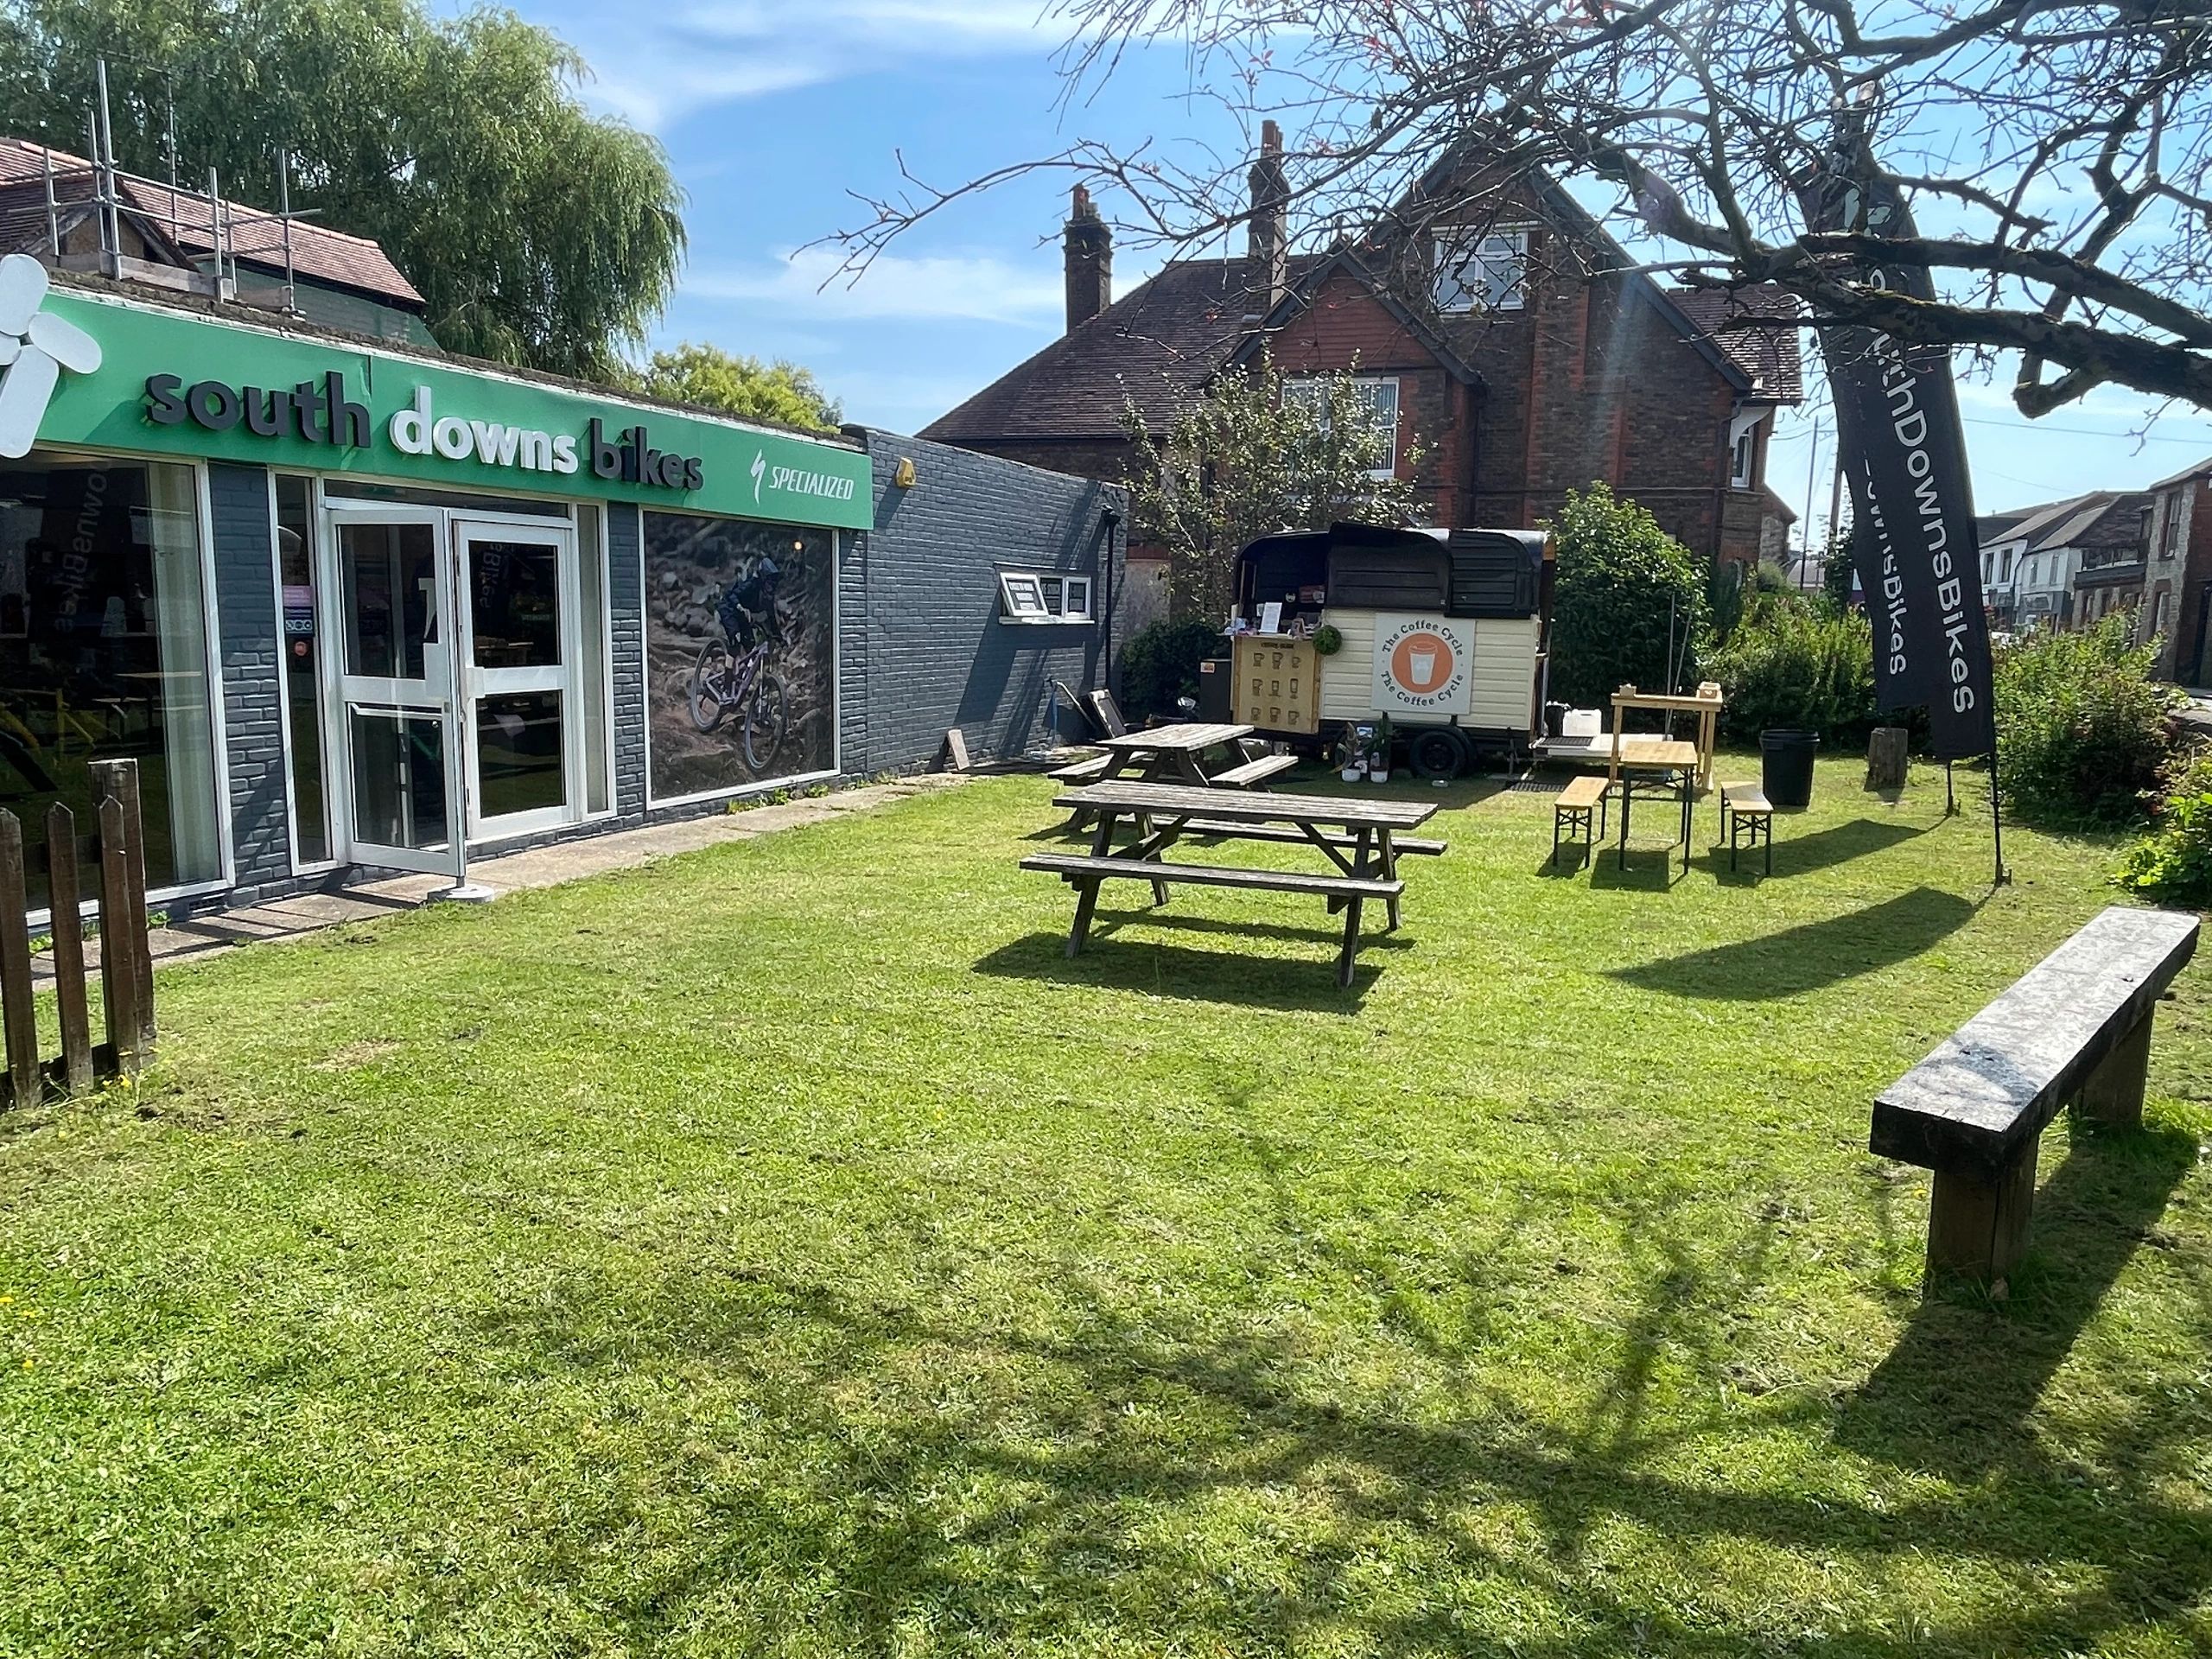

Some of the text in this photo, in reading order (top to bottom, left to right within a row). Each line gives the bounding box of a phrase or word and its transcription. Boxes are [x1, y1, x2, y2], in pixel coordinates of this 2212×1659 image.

[145, 371, 704, 491] south downs bikes
[768, 466, 855, 501] SPECIALIZED
[1382, 620, 1463, 657] The Coffee Cycle
[1381, 671, 1464, 707] The Coffee Cycle
